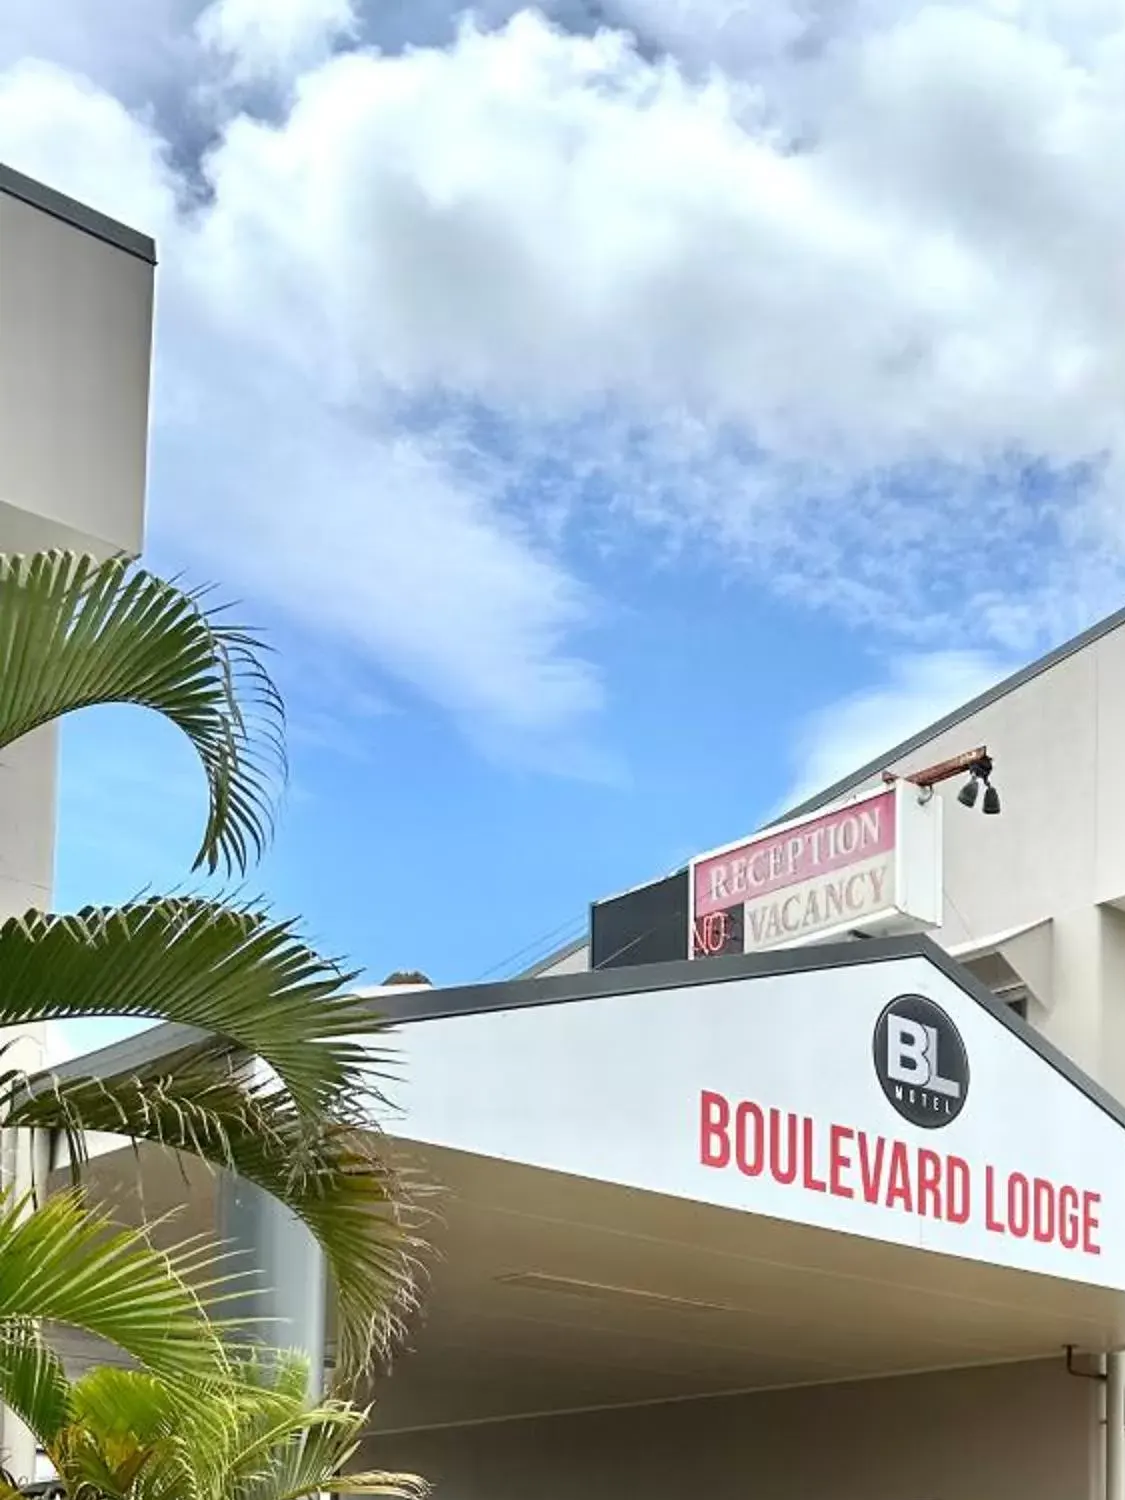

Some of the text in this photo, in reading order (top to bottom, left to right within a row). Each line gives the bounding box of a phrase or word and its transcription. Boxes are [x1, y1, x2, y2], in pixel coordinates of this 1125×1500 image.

[708, 807, 882, 900] RECEPTION
[747, 866, 888, 943] VACANCY
[887, 1013, 961, 1098] BL
[895, 1085, 952, 1116] MOTEL
[701, 1089, 1102, 1255] BOULEVARD LODGE
